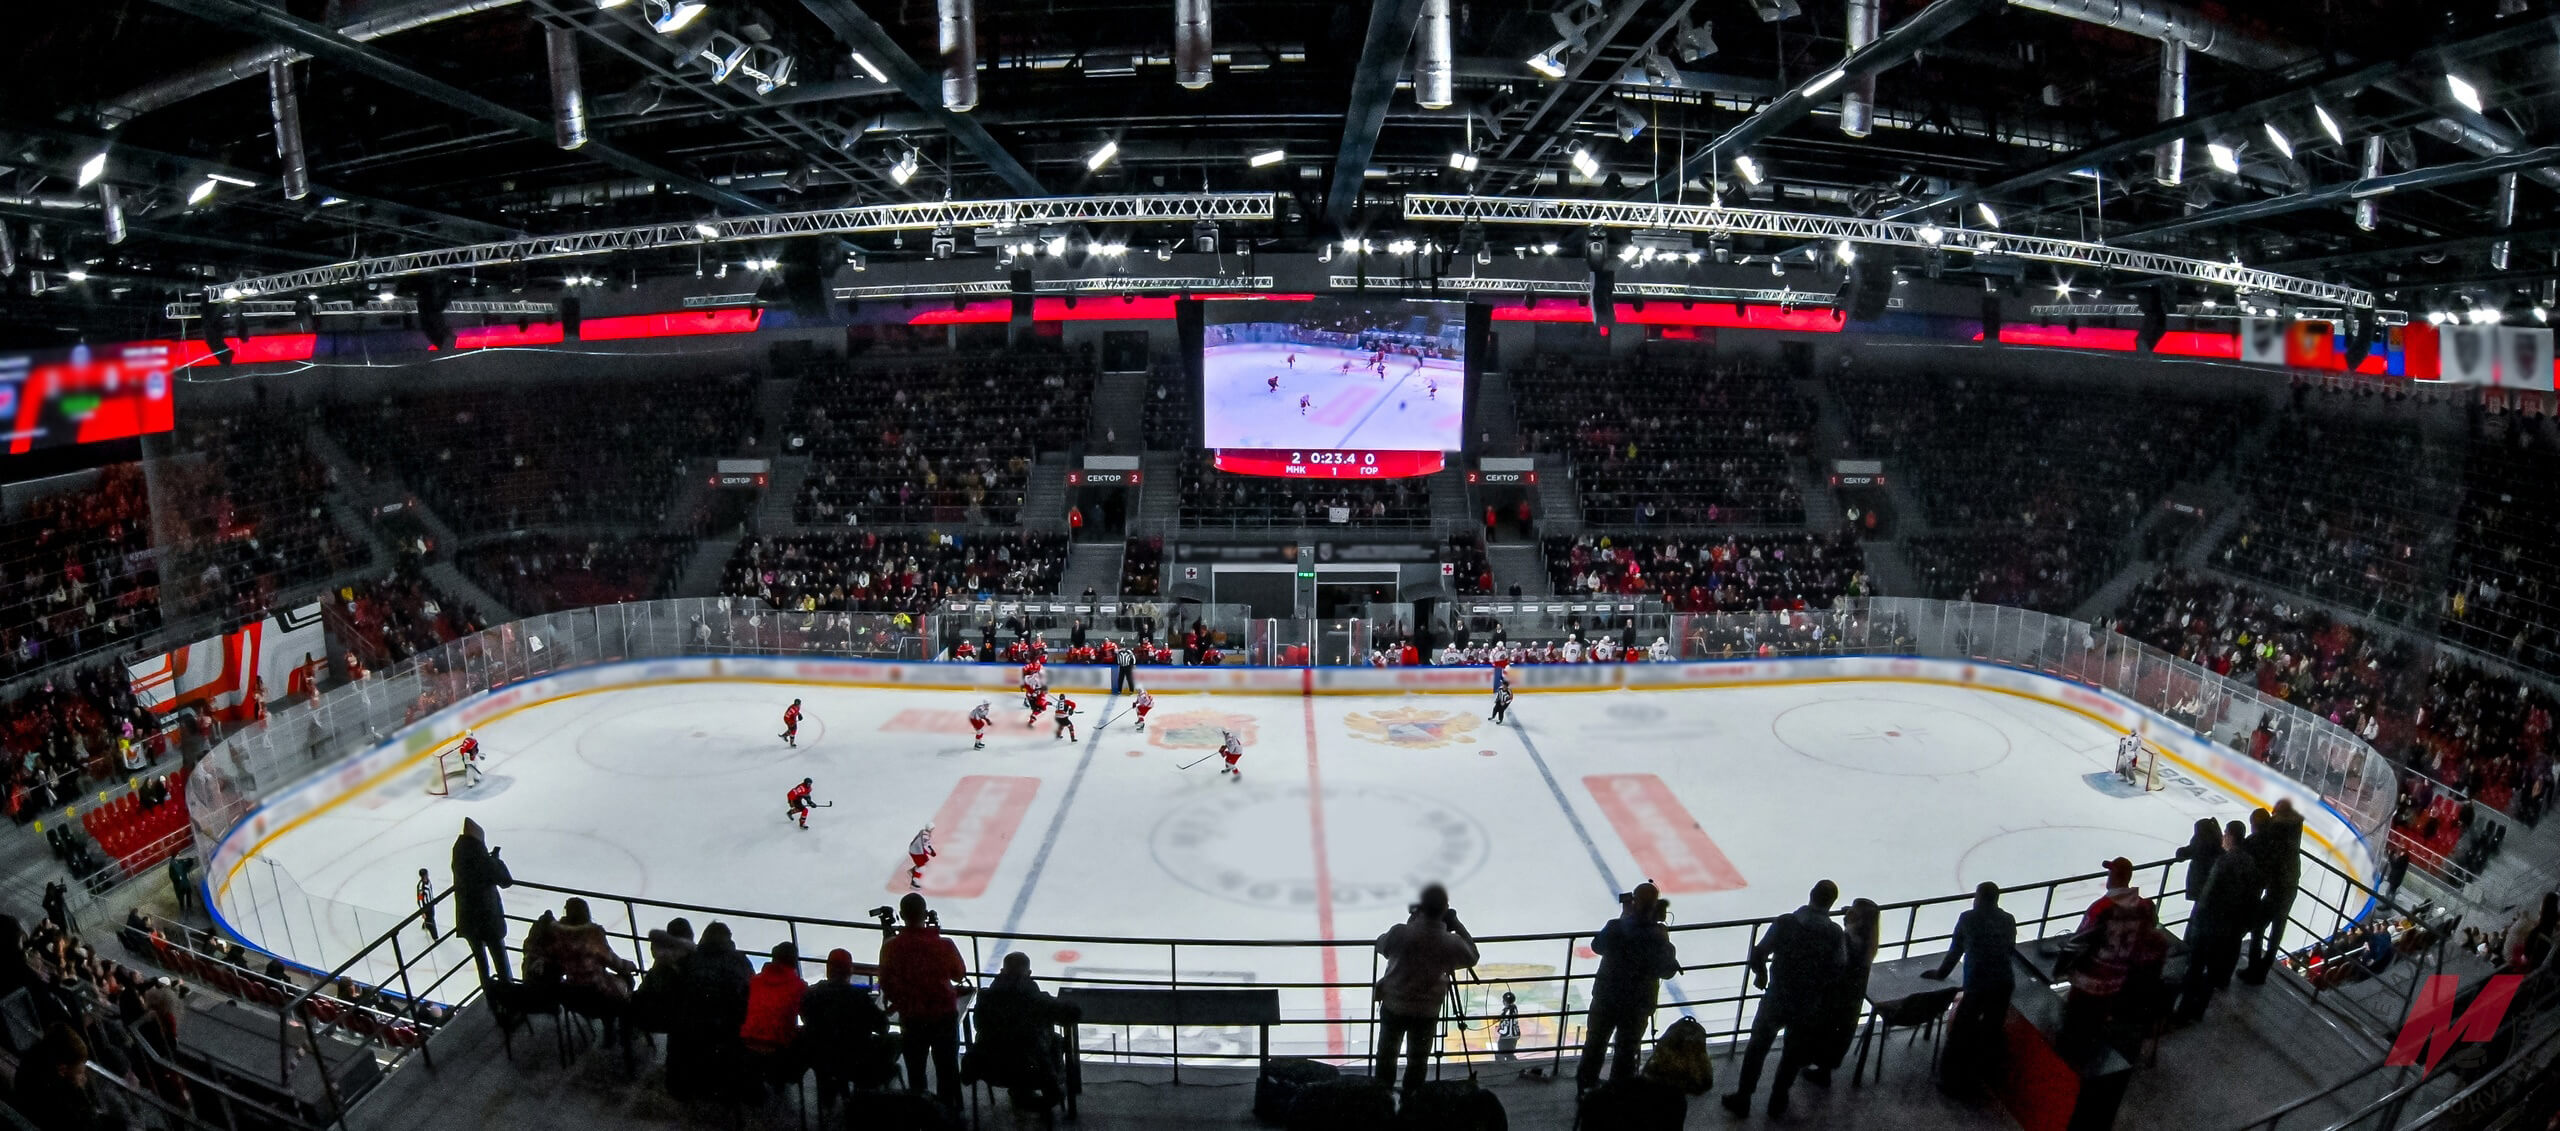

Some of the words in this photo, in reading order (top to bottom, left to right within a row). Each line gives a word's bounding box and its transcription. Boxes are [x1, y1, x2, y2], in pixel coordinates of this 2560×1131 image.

[1291, 452, 1301, 464] 2
[1310, 452, 1356, 464] 0:23.4
[1364, 453, 1375, 465] 0
[1285, 465, 1306, 474] МНК
[1331, 467, 1337, 476] 1
[1360, 466, 1378, 475] ГОР
[1070, 474, 1077, 483] 3
[1087, 474, 1121, 482] СЕКТОР
[1131, 474, 1138, 483] 2
[1469, 474, 1476, 482] 2
[1485, 474, 1519, 482] СЕКТОР
[1530, 474, 1535, 482] 1
